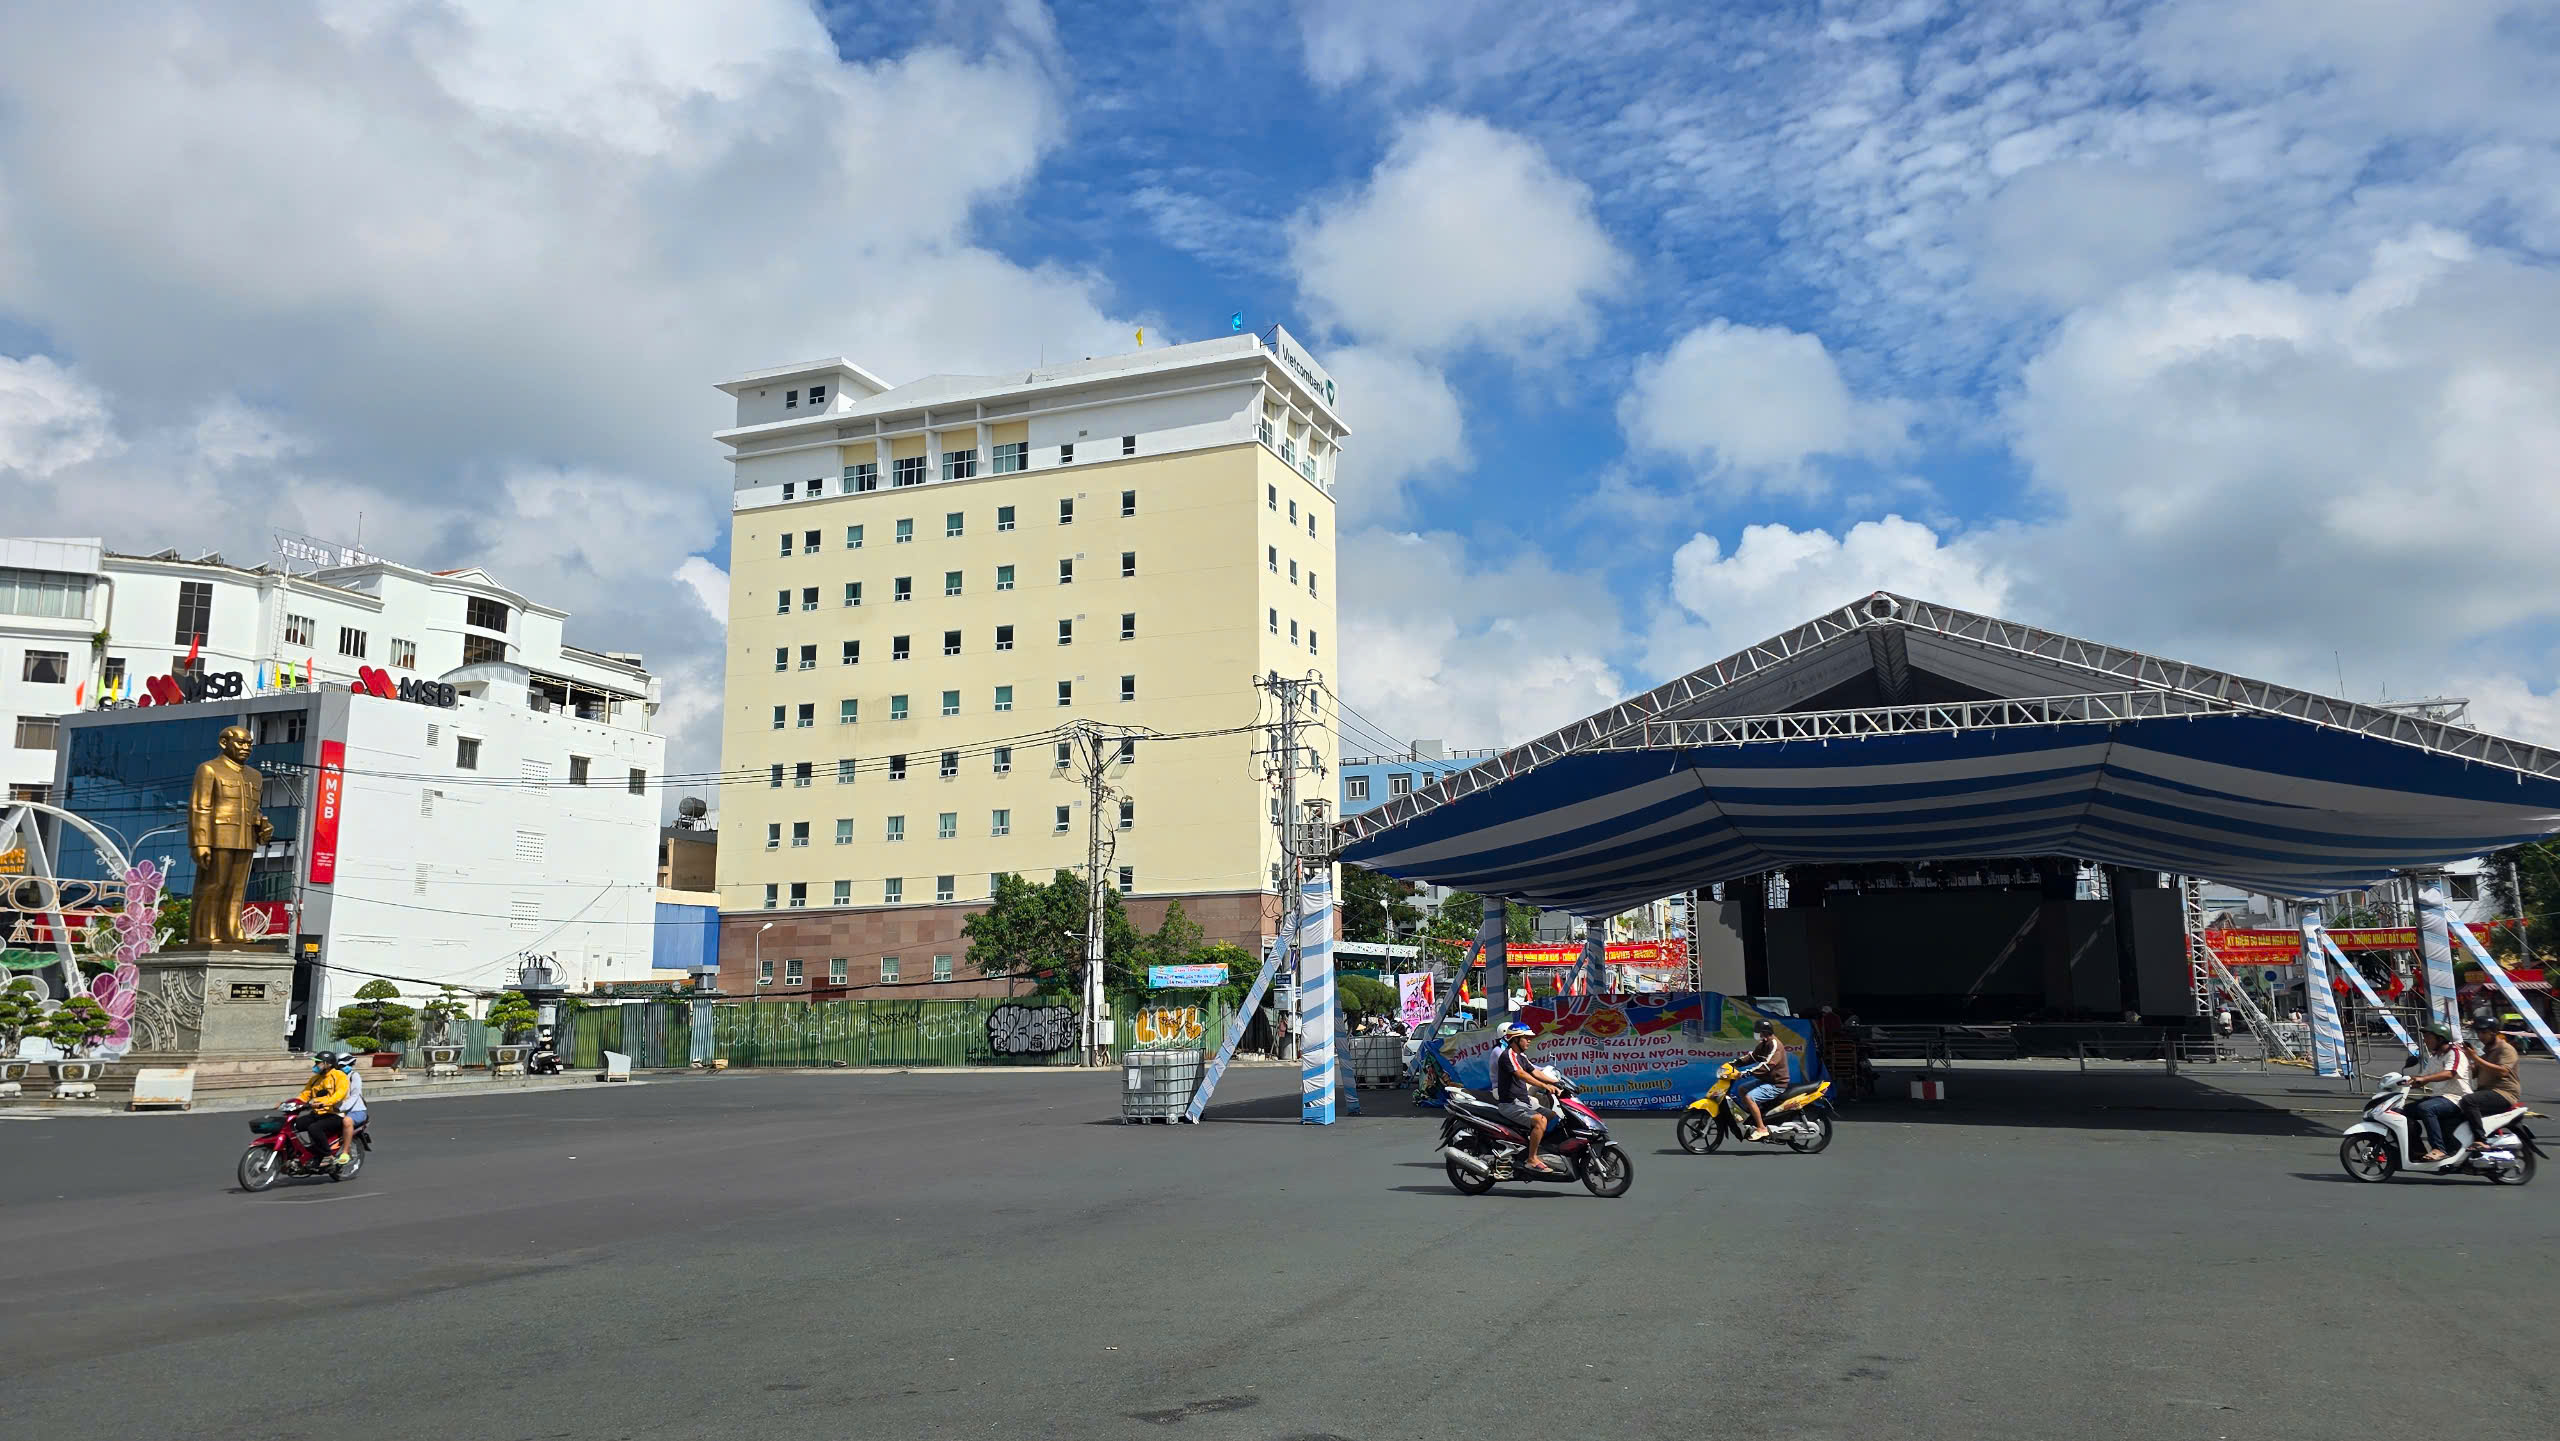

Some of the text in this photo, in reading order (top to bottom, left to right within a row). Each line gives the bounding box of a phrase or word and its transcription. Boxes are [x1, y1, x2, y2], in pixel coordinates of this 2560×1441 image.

[1282, 344, 1325, 398] Vietcombank
[185, 671, 243, 703] MSB
[401, 676, 456, 707] MSB
[324, 778, 338, 819] MSB
[0, 876, 127, 918] 025
[1471, 1042, 1489, 1058] ĐẤT
[1581, 1050, 1609, 1064] MIỀN
[1613, 1051, 1646, 1063] TOÀN
[1648, 1048, 1685, 1060] HOÀN
[1563, 1059, 1689, 1078] CHÀO MỪNG KỶ NIỆM
[1606, 1099, 1626, 1107] VĂN
[1629, 1097, 1649, 1107] TÂM
[1650, 1094, 1682, 1104] TRUNG
